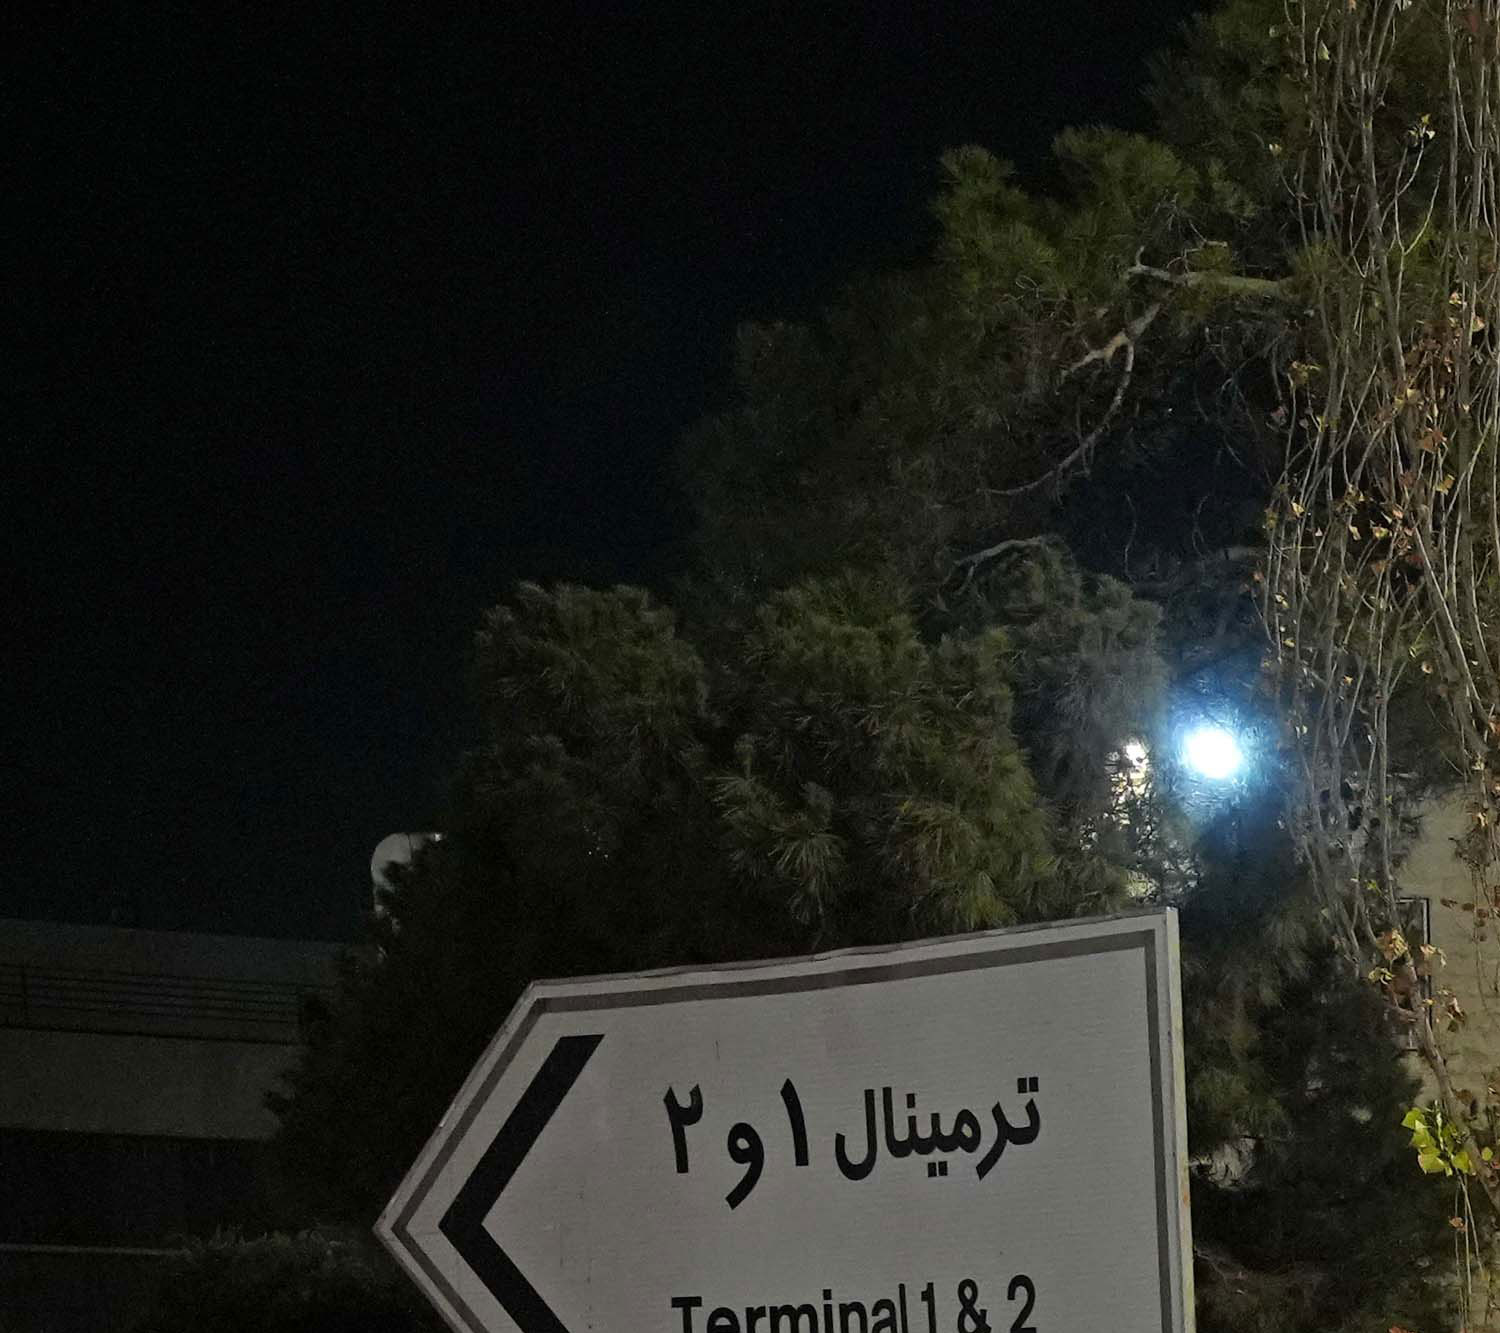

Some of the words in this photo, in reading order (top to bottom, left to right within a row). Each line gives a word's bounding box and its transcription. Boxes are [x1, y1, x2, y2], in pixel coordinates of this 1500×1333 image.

[662, 1082, 704, 1174] ۲
[725, 1121, 765, 1210] و
[780, 1078, 810, 1168] ۱
[835, 1076, 1041, 1182] ترمینال
